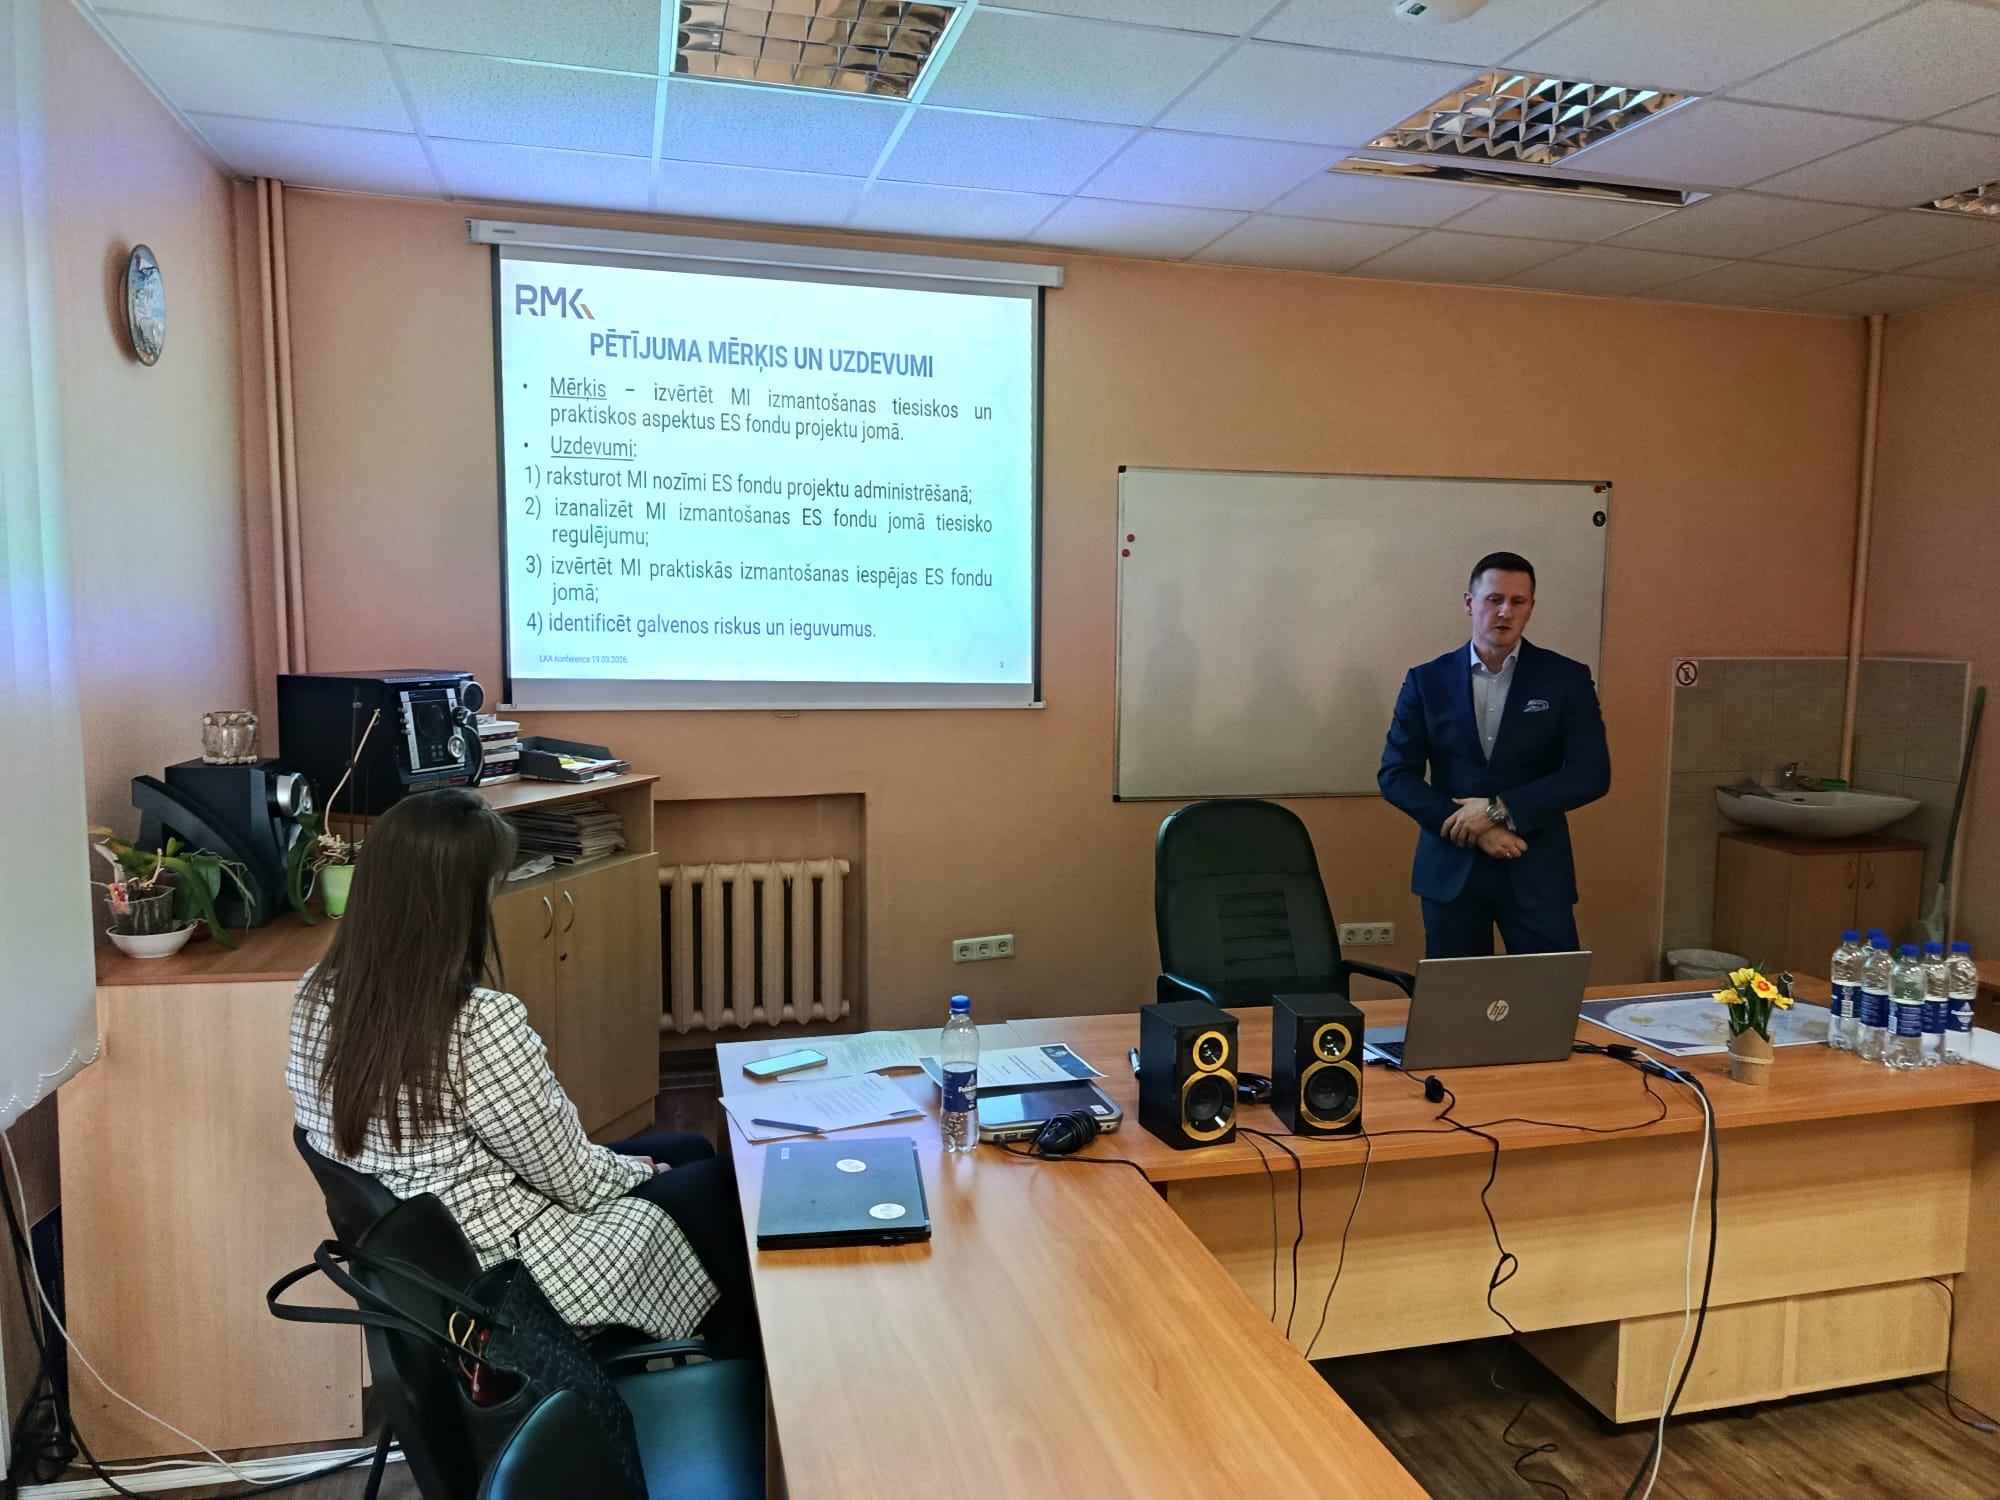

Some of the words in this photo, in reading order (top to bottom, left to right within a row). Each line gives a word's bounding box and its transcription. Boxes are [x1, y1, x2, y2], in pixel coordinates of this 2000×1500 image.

[516, 284, 594, 320] RMK
[591, 329, 702, 362] PĒTĪJUMA
[709, 337, 787, 373] MĒRĶIS
[795, 347, 822, 370] UN
[830, 349, 933, 377] UZDEVUMI
[550, 377, 607, 401] Mērķis
[655, 383, 713, 403] izvērtēt
[732, 388, 749, 406] MI
[769, 390, 876, 413] izmantošanas
[892, 397, 958, 418] tiesiskos
[975, 406, 991, 420] un
[551, 404, 636, 426] praktiskos
[643, 410, 715, 432] aspektus
[721, 413, 740, 431] ES
[746, 413, 790, 434] fondu
[796, 418, 857, 441] projektu
[861, 421, 903, 443] jomā.
[551, 435, 636, 457] Uzdevumi:
[525, 464, 540, 488] 1)
[547, 466, 622, 487] raksturot
[628, 470, 646, 488] MI
[653, 473, 706, 491] nozīmi
[713, 474, 732, 492] ES
[737, 474, 781, 494] fondu
[788, 478, 848, 501] projektu
[855, 480, 971, 504] administrēšanā;
[525, 496, 540, 520] 2)
[555, 498, 633, 518] izanalizēt
[647, 502, 665, 520] MI
[680, 503, 790, 524] izmantošanas
[803, 508, 821, 525] ES
[833, 508, 876, 528] fondu
[888, 512, 925, 533] jomā
[936, 514, 992, 532] tiesisko
[553, 524, 648, 548] regulējumu;
[526, 554, 541, 578] 3)
[552, 556, 612, 575] izvērtēt
[621, 558, 640, 576] MI
[650, 559, 732, 581] praktiskās
[741, 562, 848, 582] izmantošanas
[857, 566, 917, 588] iespējas
[926, 568, 943, 585] ES
[951, 568, 992, 586] fondu
[552, 583, 598, 605] jomā;
[527, 612, 542, 636] 4)
[550, 612, 631, 632] identificēt
[637, 614, 708, 637] galvenos
[715, 616, 760, 634] riskus
[766, 622, 784, 635] un
[790, 618, 876, 640] ieguvumus.
[555, 655, 590, 663] konference
[1488, 1000, 1509, 1021] hp
